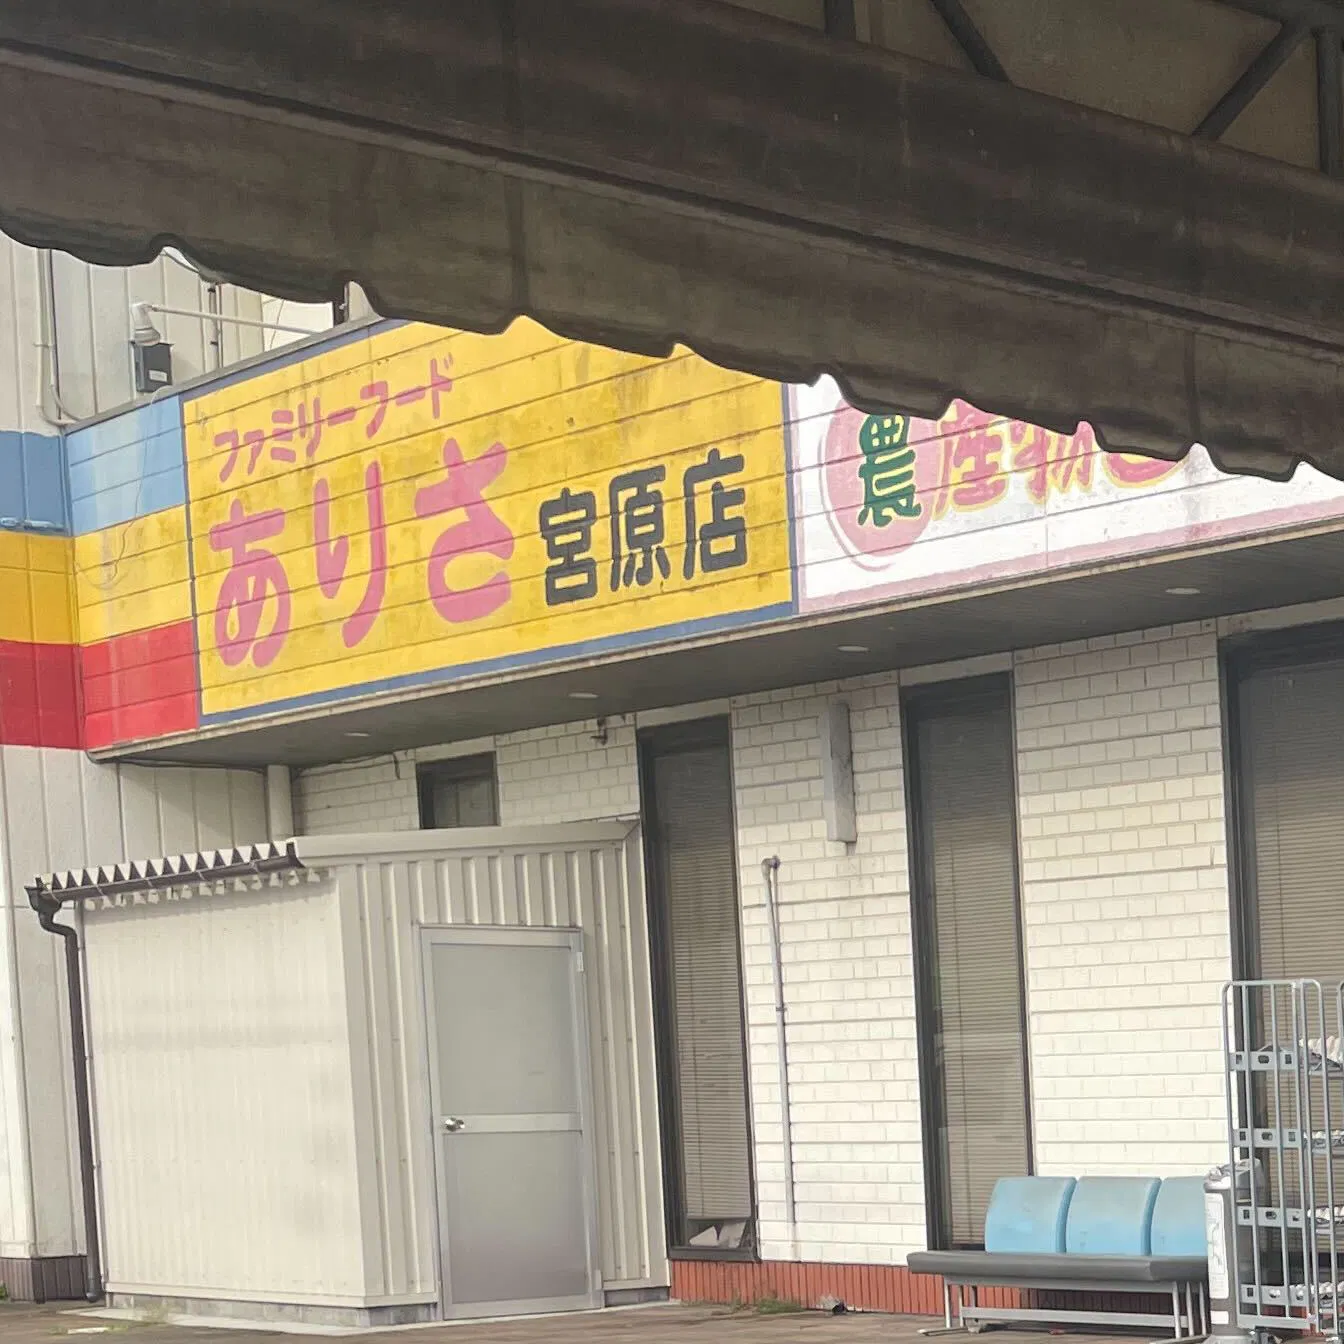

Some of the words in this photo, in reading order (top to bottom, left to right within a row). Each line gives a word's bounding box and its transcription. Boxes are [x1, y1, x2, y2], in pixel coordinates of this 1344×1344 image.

[214, 352, 458, 483] ファミリーフード
[858, 397, 1188, 528] 農産物
[208, 436, 516, 668] ありさ
[539, 447, 747, 607] 宮原店
